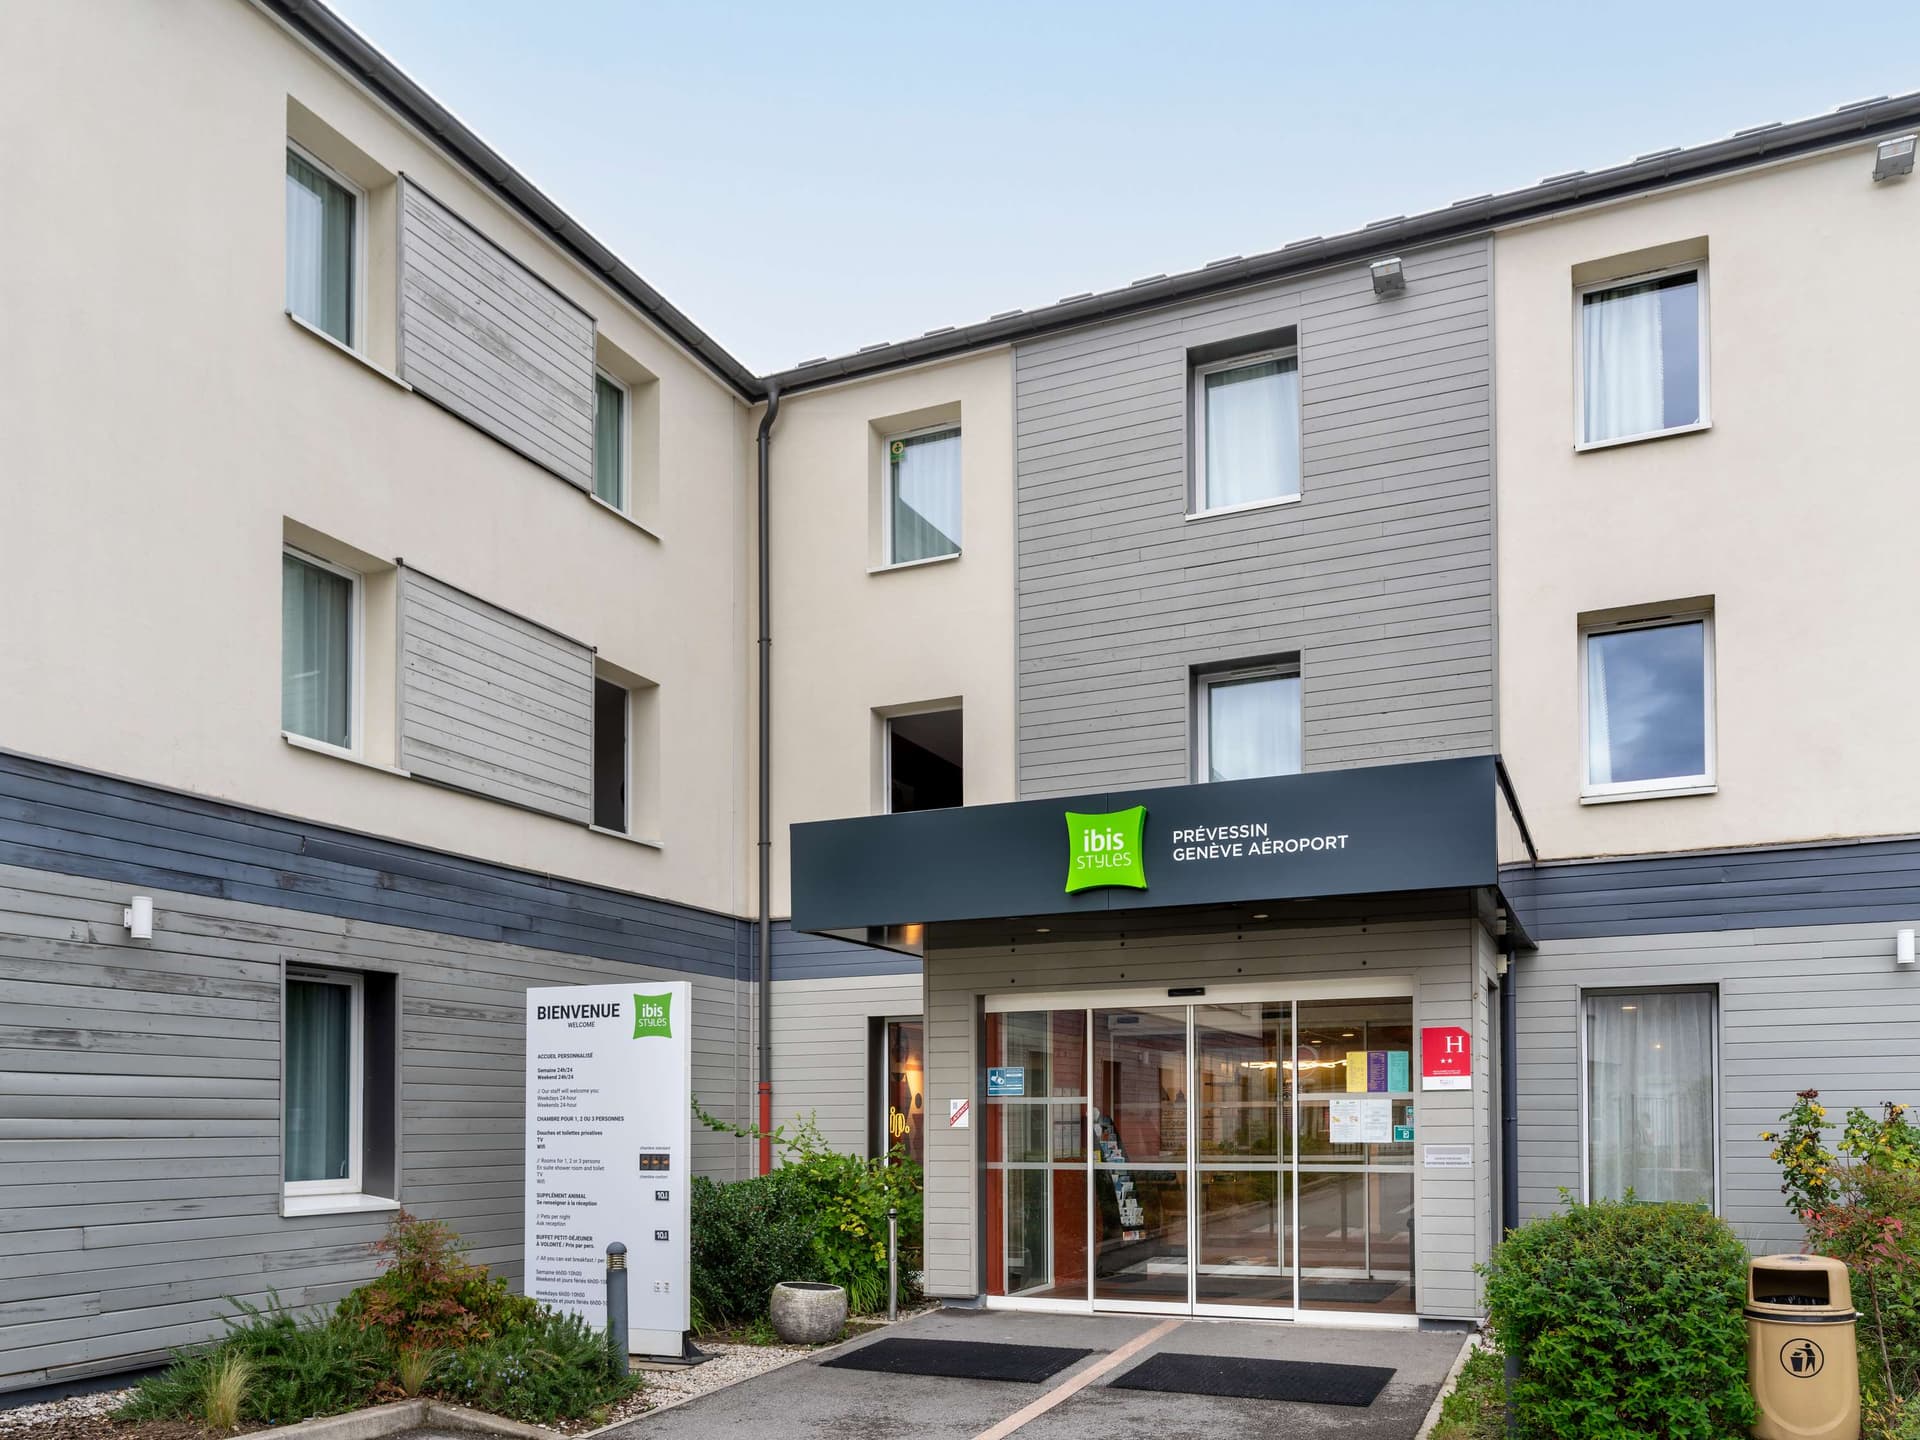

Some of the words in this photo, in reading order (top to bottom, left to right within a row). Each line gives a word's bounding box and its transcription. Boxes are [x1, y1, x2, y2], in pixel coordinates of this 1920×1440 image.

[1083, 827, 1124, 853] ibis
[1173, 823, 1268, 844] PRÉVESSIN
[1173, 842, 1243, 861] GENÈVE
[1248, 834, 1349, 856] AÉROPORT
[537, 1003, 620, 1020] BIENVENUE
[642, 1003, 663, 1018] ibis
[1444, 1035, 1464, 1053] H
